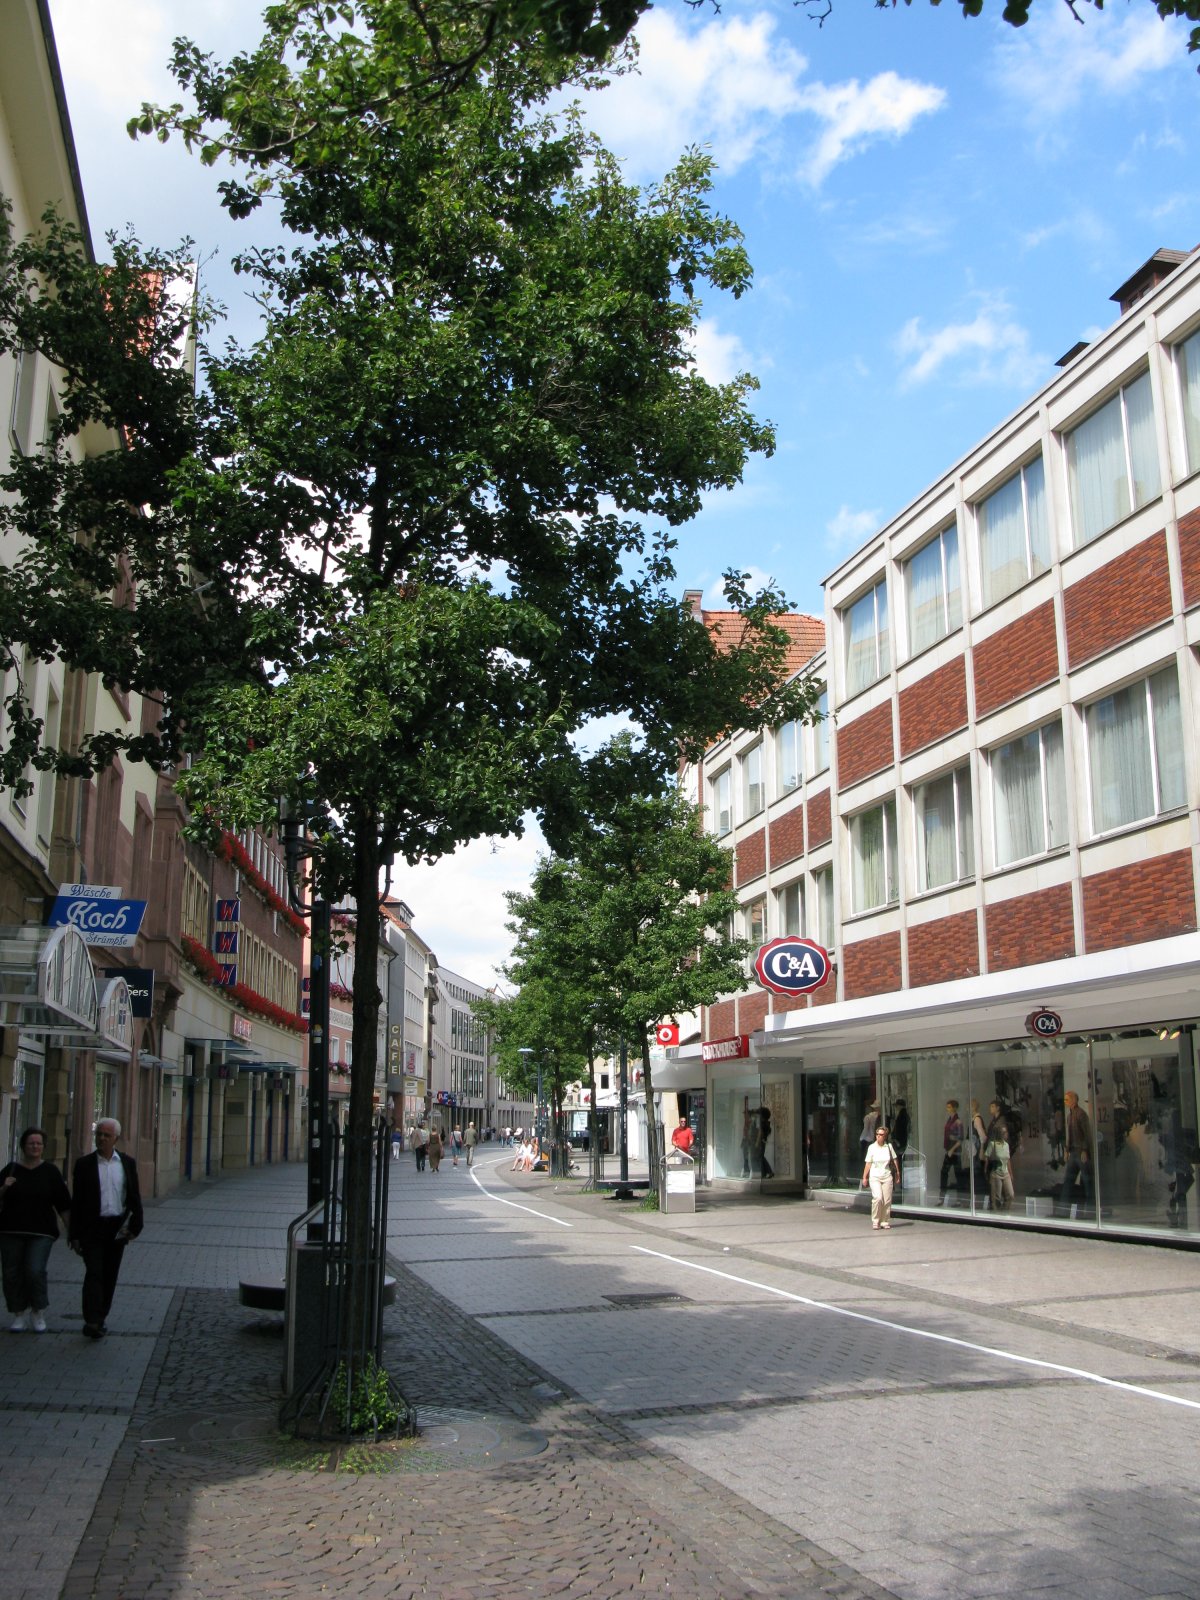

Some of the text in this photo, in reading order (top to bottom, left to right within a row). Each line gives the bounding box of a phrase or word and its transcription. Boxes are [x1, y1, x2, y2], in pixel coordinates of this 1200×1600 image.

[70, 884, 112, 899] Wäsche
[56, 900, 131, 930] Koch
[86, 932, 128, 946] Strümpfe
[771, 952, 819, 978] C&A
[1037, 1017, 1057, 1030] C&A
